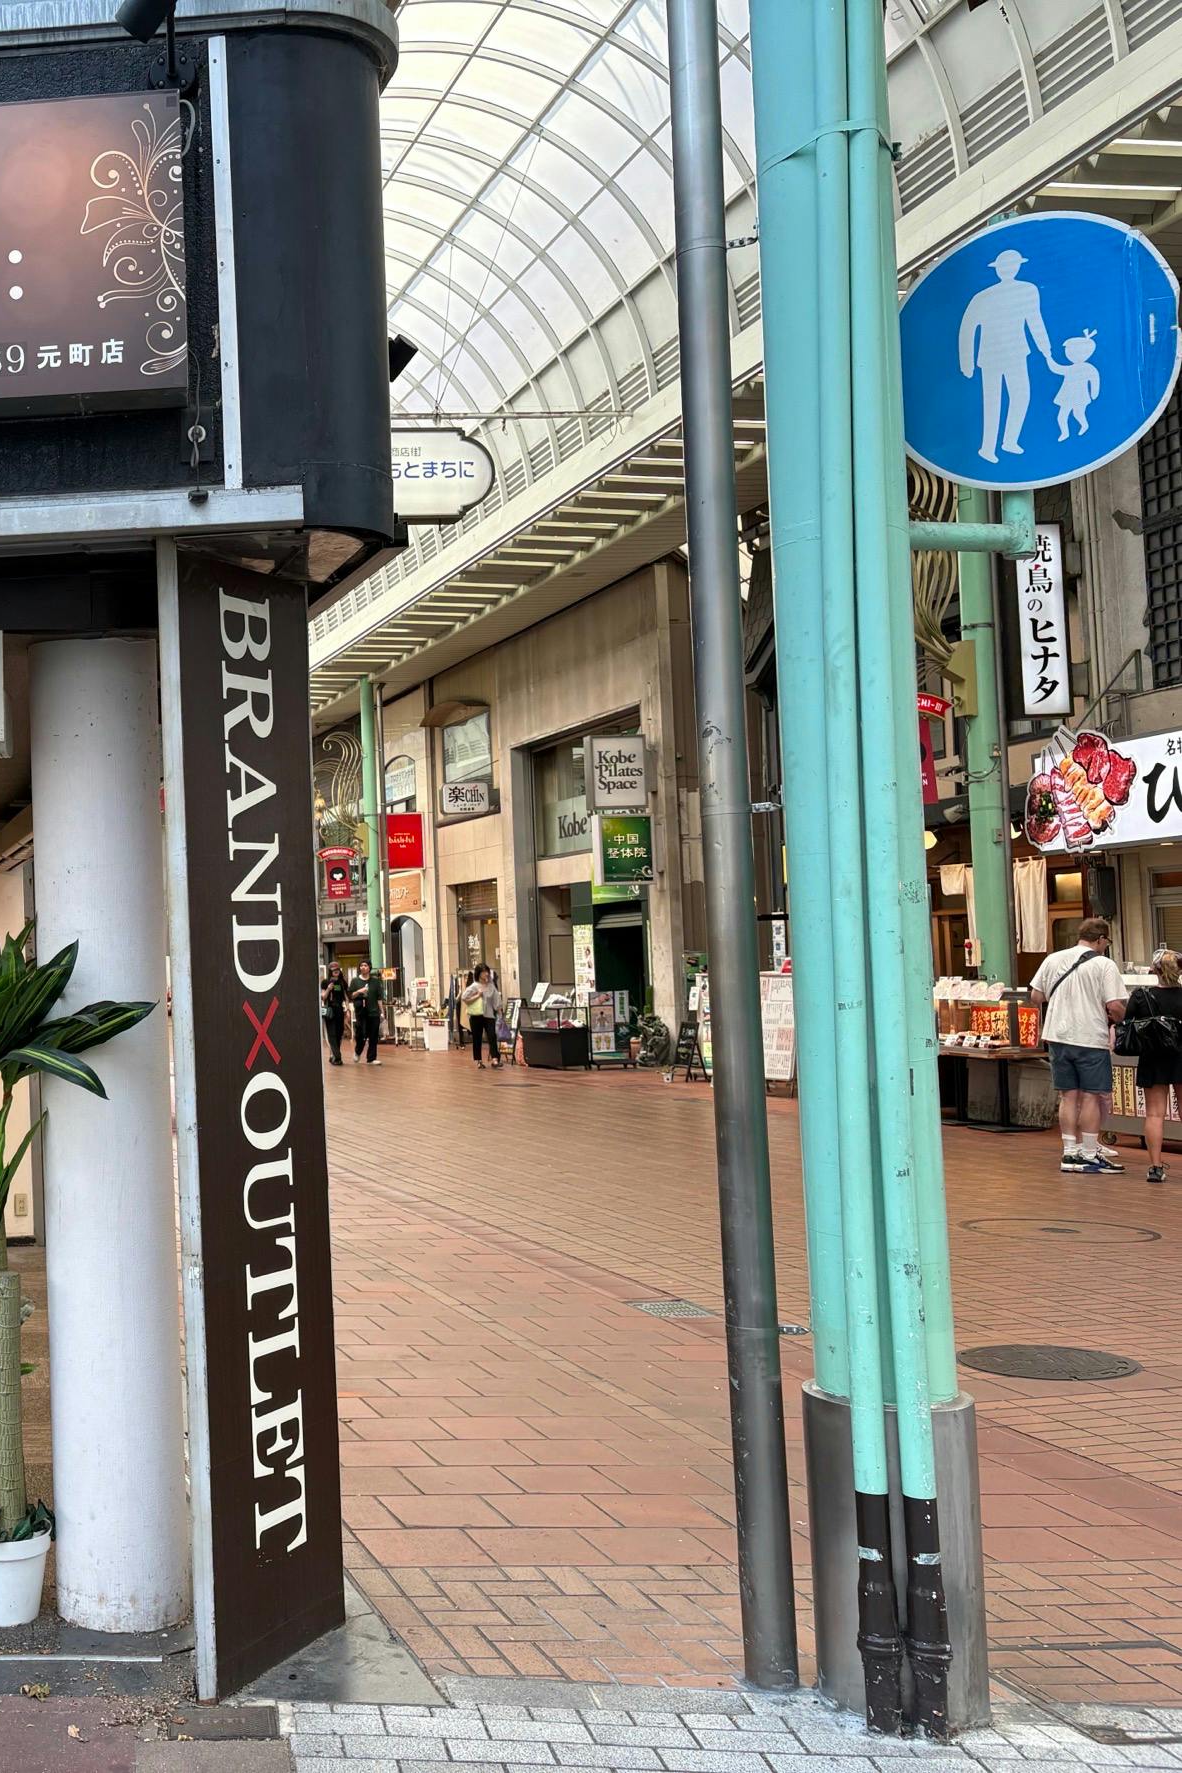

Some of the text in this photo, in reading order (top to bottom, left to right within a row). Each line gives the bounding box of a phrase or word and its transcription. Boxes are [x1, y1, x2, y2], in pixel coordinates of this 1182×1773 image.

[36, 338, 125, 369] 元町店
[597, 749, 637, 764] Kobe
[594, 762, 644, 778] Pilates
[597, 775, 638, 795] Space
[557, 811, 588, 840] Kobe
[613, 833, 639, 845] 中国
